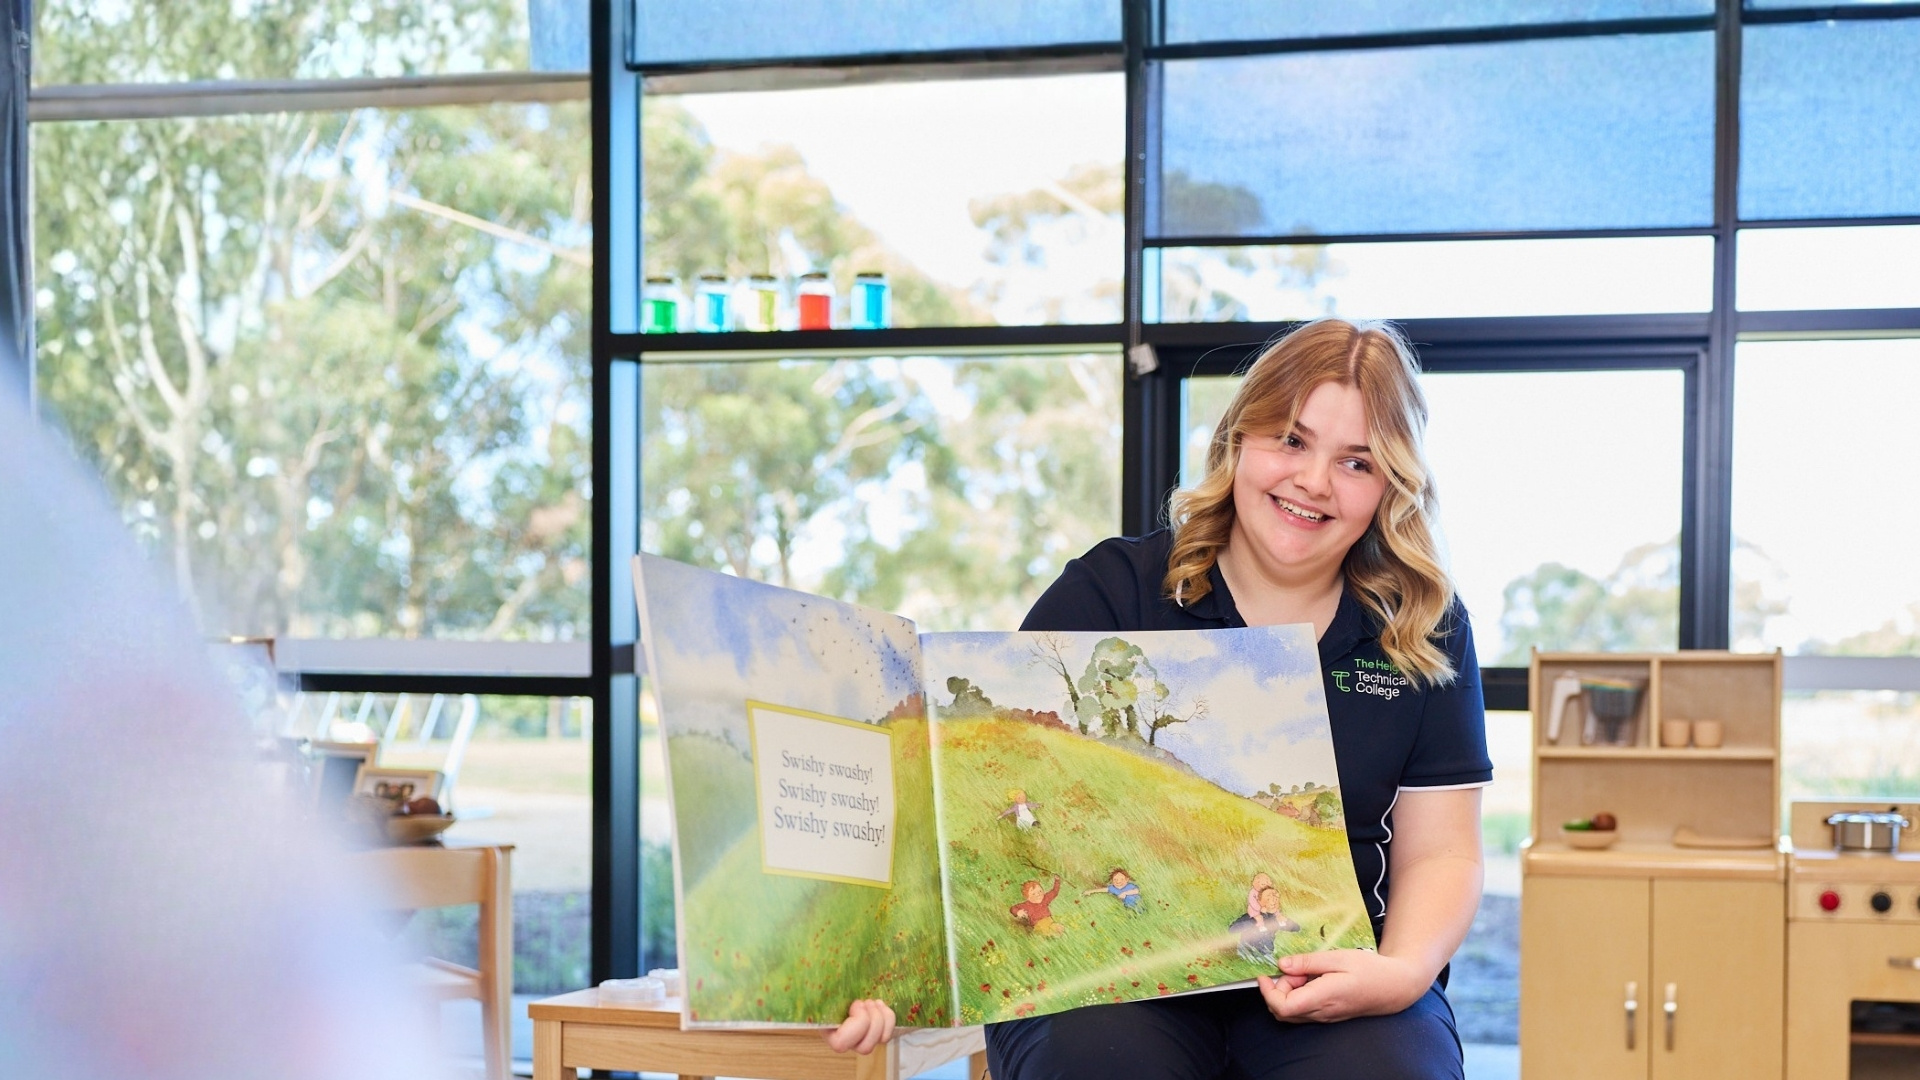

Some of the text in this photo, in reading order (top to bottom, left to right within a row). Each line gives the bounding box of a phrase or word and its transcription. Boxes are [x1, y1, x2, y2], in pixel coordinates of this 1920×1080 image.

[1354, 658, 1375, 669] The
[1354, 670, 1409, 686] Technical
[1355, 682, 1400, 700] College
[781, 750, 873, 785] Swishy swashy!
[778, 778, 880, 816] Swishy swashy!
[774, 806, 886, 847] Swishy swashy!
